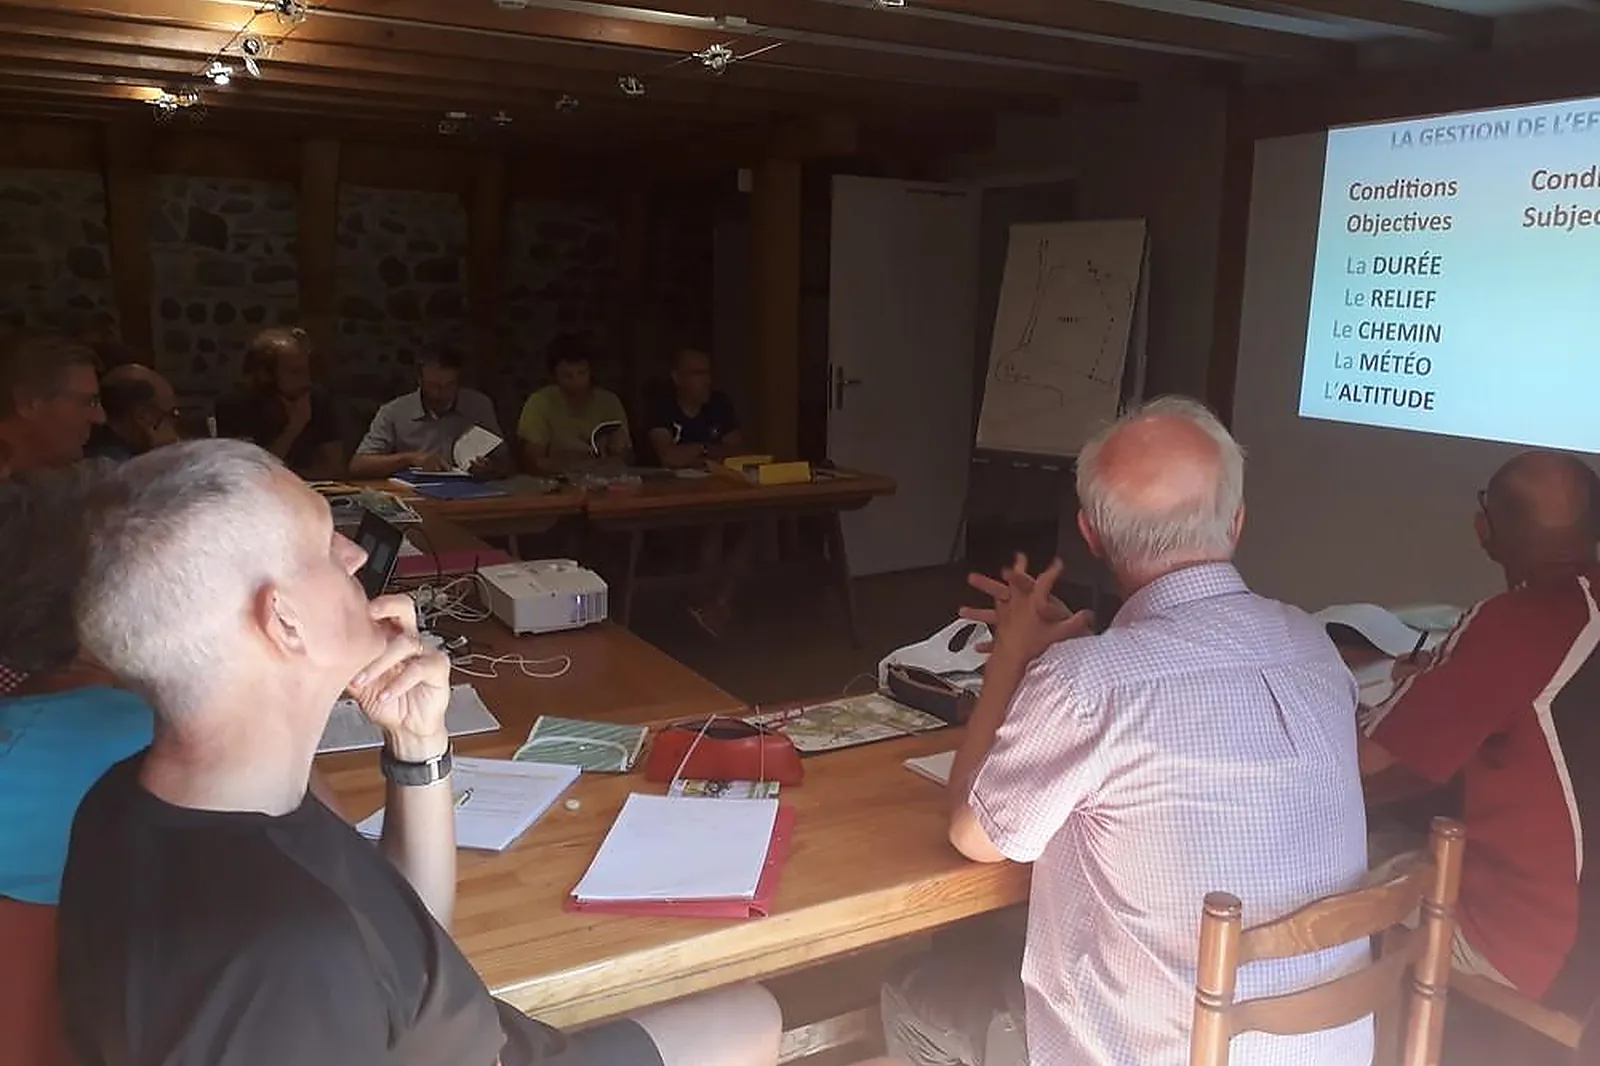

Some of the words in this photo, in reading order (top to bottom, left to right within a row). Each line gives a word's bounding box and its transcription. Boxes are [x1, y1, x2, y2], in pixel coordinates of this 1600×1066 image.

[1391, 131, 1413, 149] LA
[1419, 121, 1511, 147] GESTION
[1518, 117, 1545, 138] DE
[1349, 178, 1458, 201] Conditions
[1347, 212, 1453, 236] Objectives
[1347, 256, 1366, 275] La
[1373, 251, 1442, 275] DURÉE
[1344, 288, 1365, 306] Le
[1370, 289, 1436, 309] RELIEF
[1332, 320, 1352, 339] Le
[1358, 321, 1442, 344] CHEMIN
[1334, 352, 1353, 370] La
[1359, 350, 1432, 376] MÉTÉO
[1324, 381, 1435, 410] L'ALTITUDE
